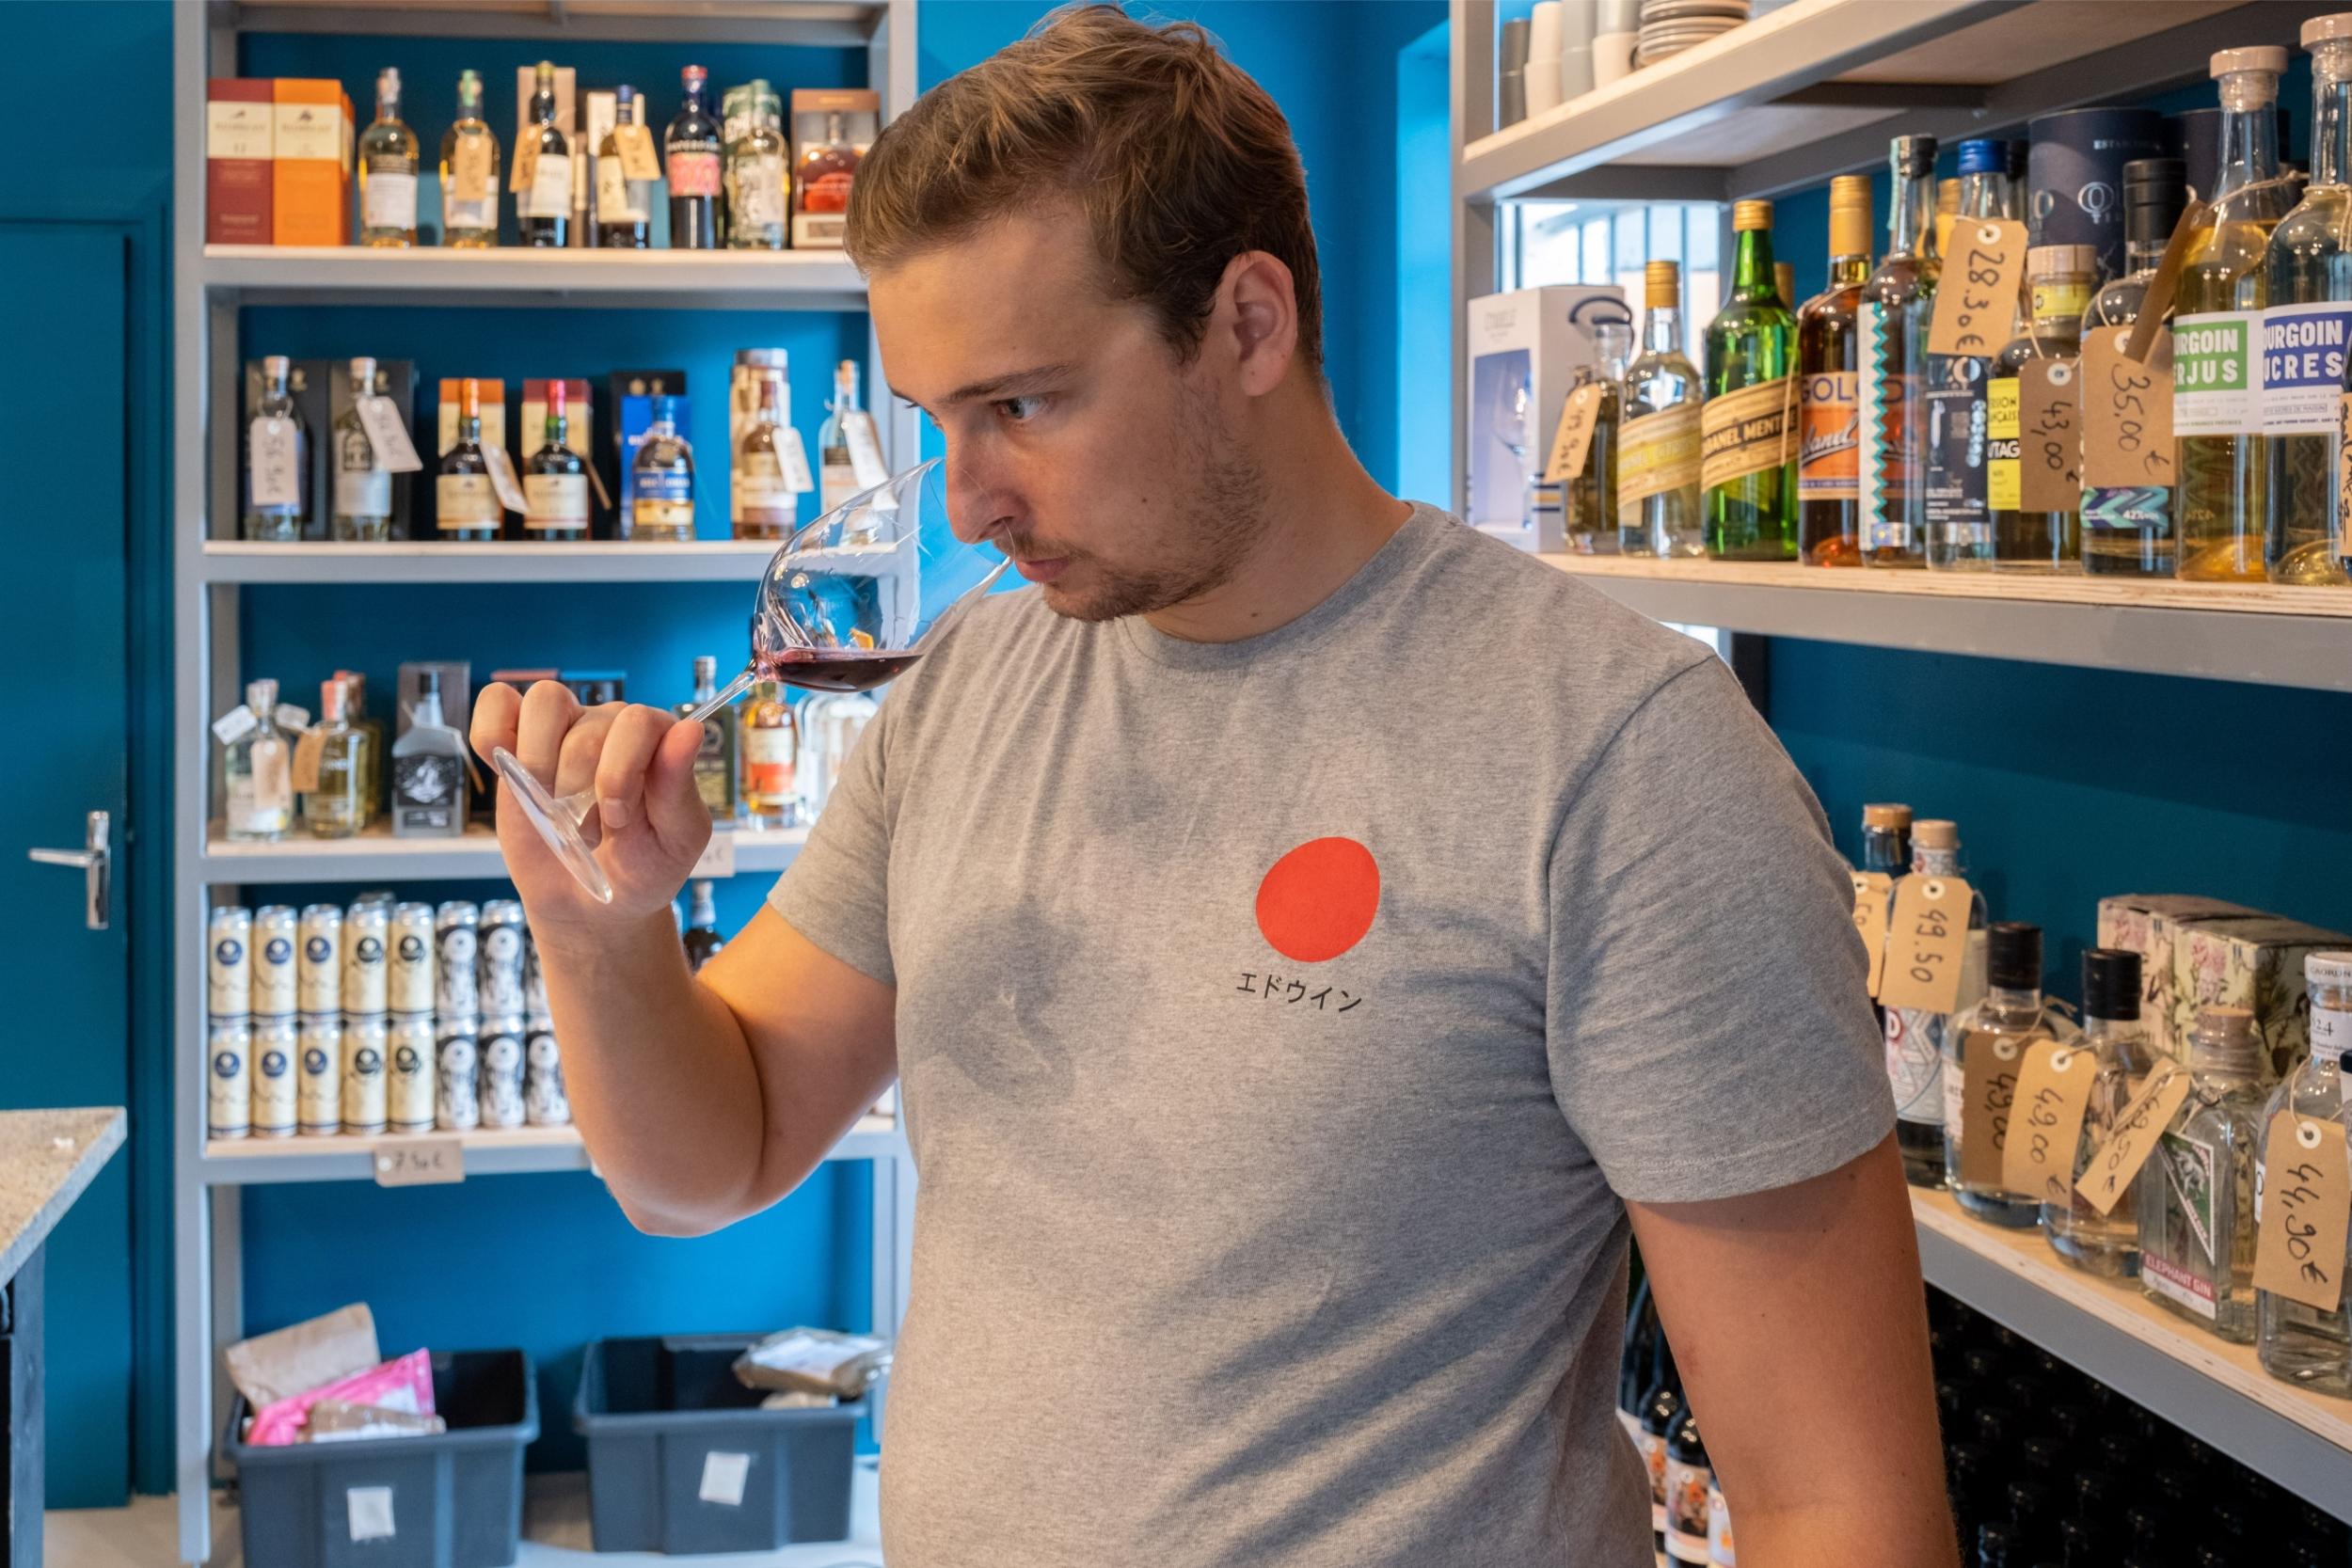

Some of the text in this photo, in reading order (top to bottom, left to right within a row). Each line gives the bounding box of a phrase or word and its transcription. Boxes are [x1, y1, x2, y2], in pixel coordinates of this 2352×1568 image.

[1236, 973, 1362, 1012] エドウイン
